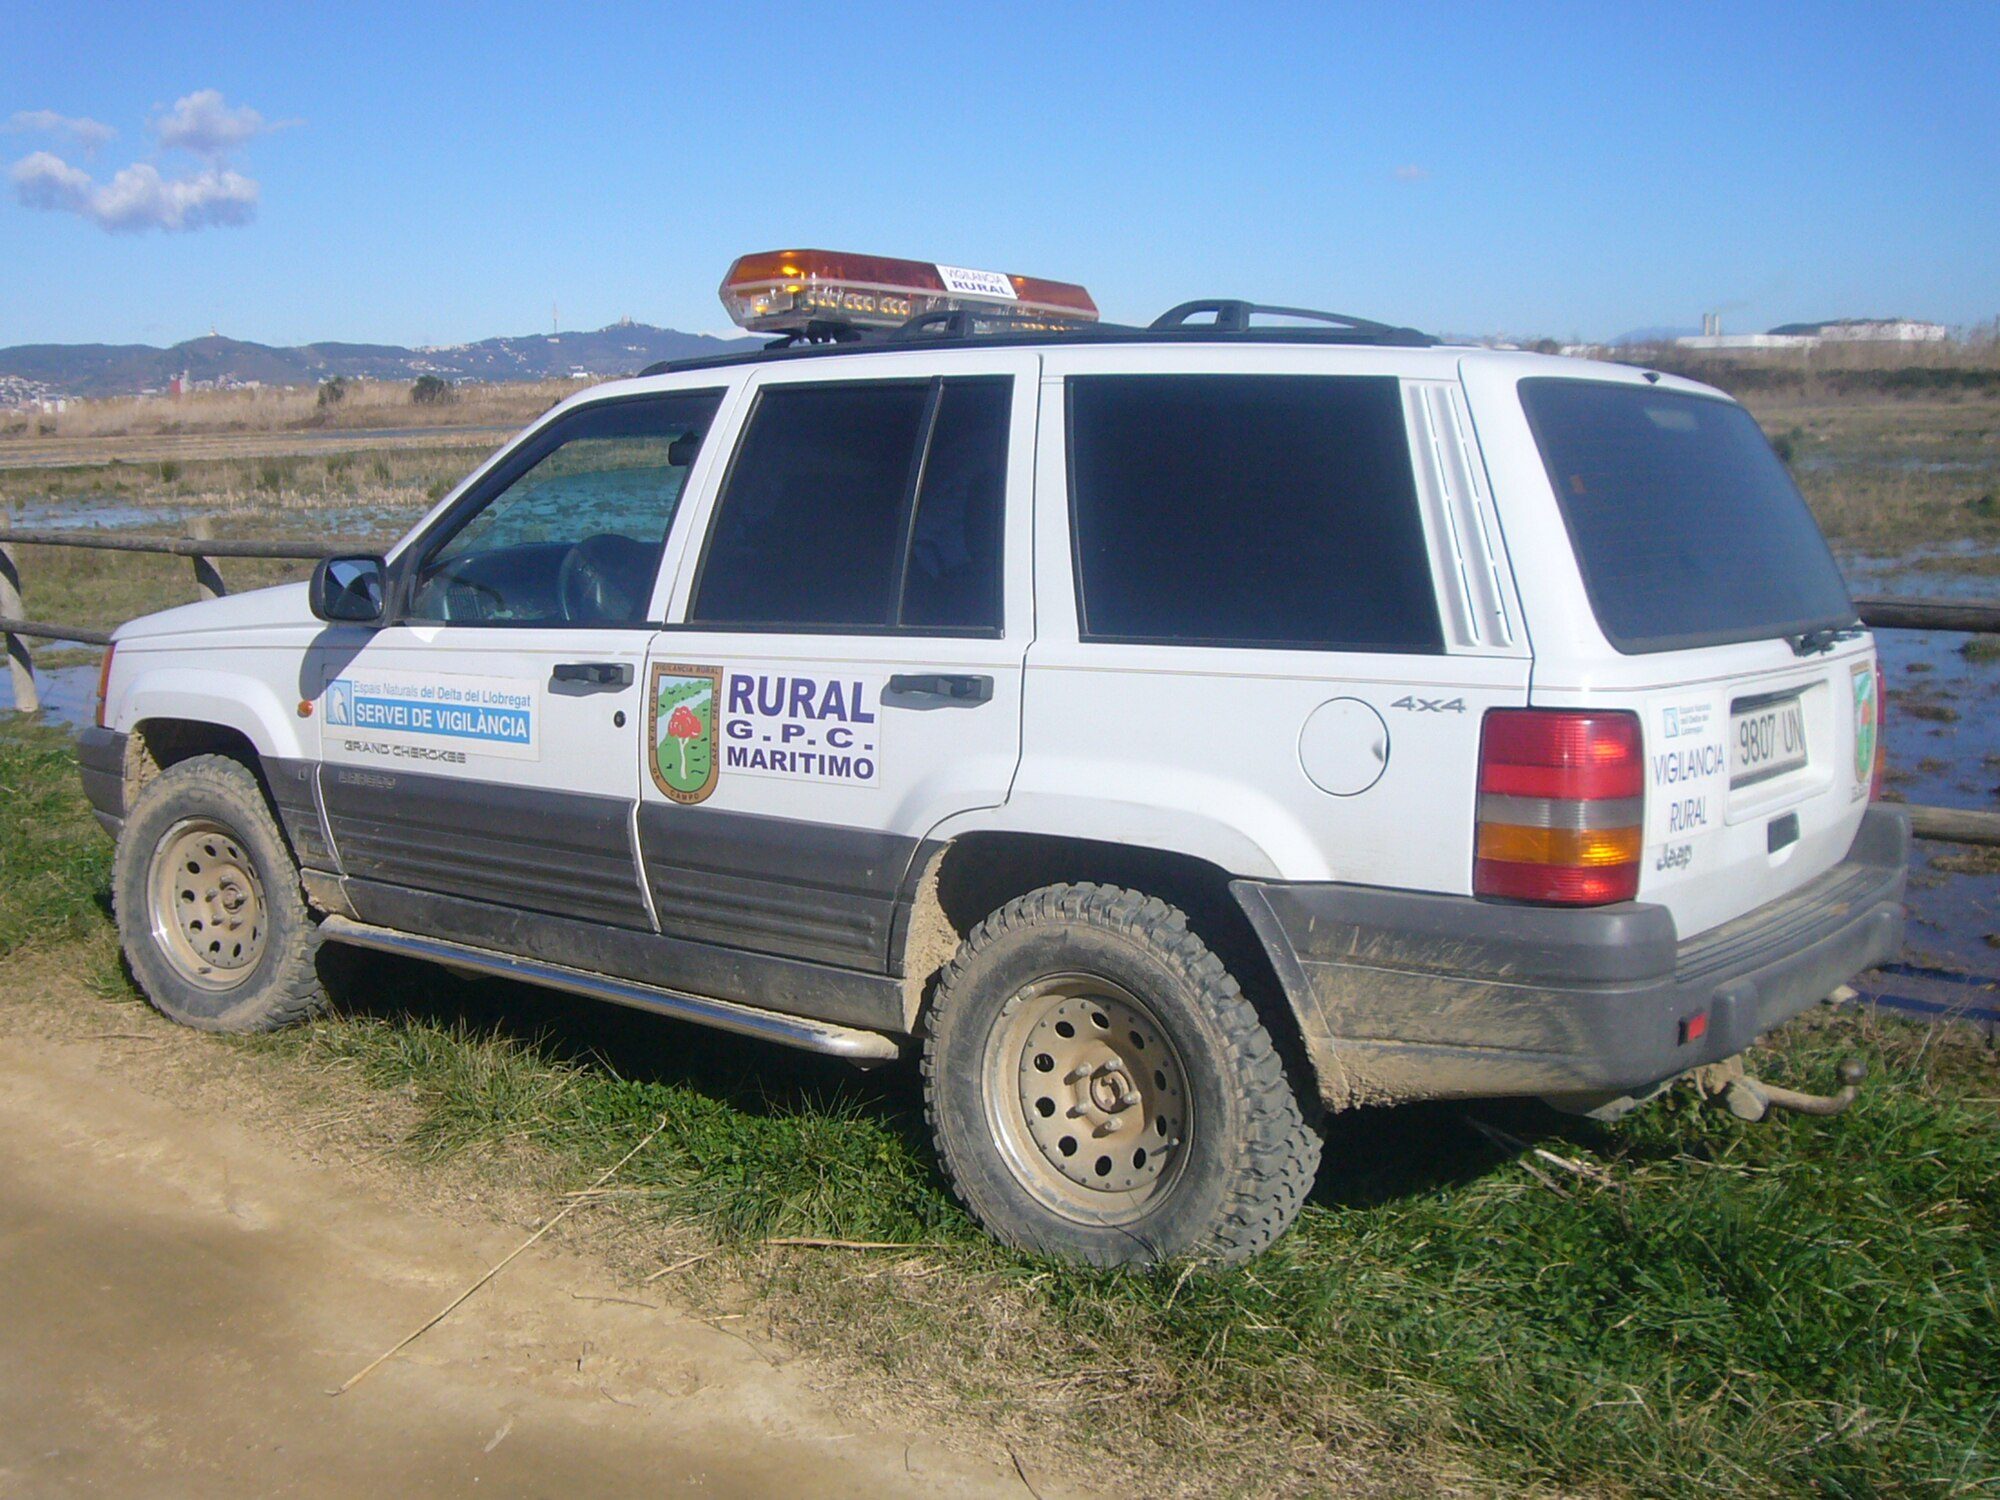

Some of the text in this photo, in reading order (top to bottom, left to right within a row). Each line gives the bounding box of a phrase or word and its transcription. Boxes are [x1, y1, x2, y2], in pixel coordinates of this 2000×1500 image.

[952, 280, 1011, 296] RURAL
[353, 680, 531, 709] Espais Naturals del Delta del Llobregat
[728, 674, 875, 723] RURAL
[356, 703, 528, 738] SERVEI DE VIGILÀNCIA
[726, 719, 874, 751] G.P.C.
[1740, 707, 1804, 766] 9807 UN
[344, 740, 466, 764] GRAND CHEROKEE
[727, 745, 875, 780] MARITIMO
[1653, 744, 1725, 786] VIGILANCIA
[670, 790, 700, 800] CAMPO
[1670, 796, 1708, 833] RURAL
[1656, 843, 1693, 872] Jeep
